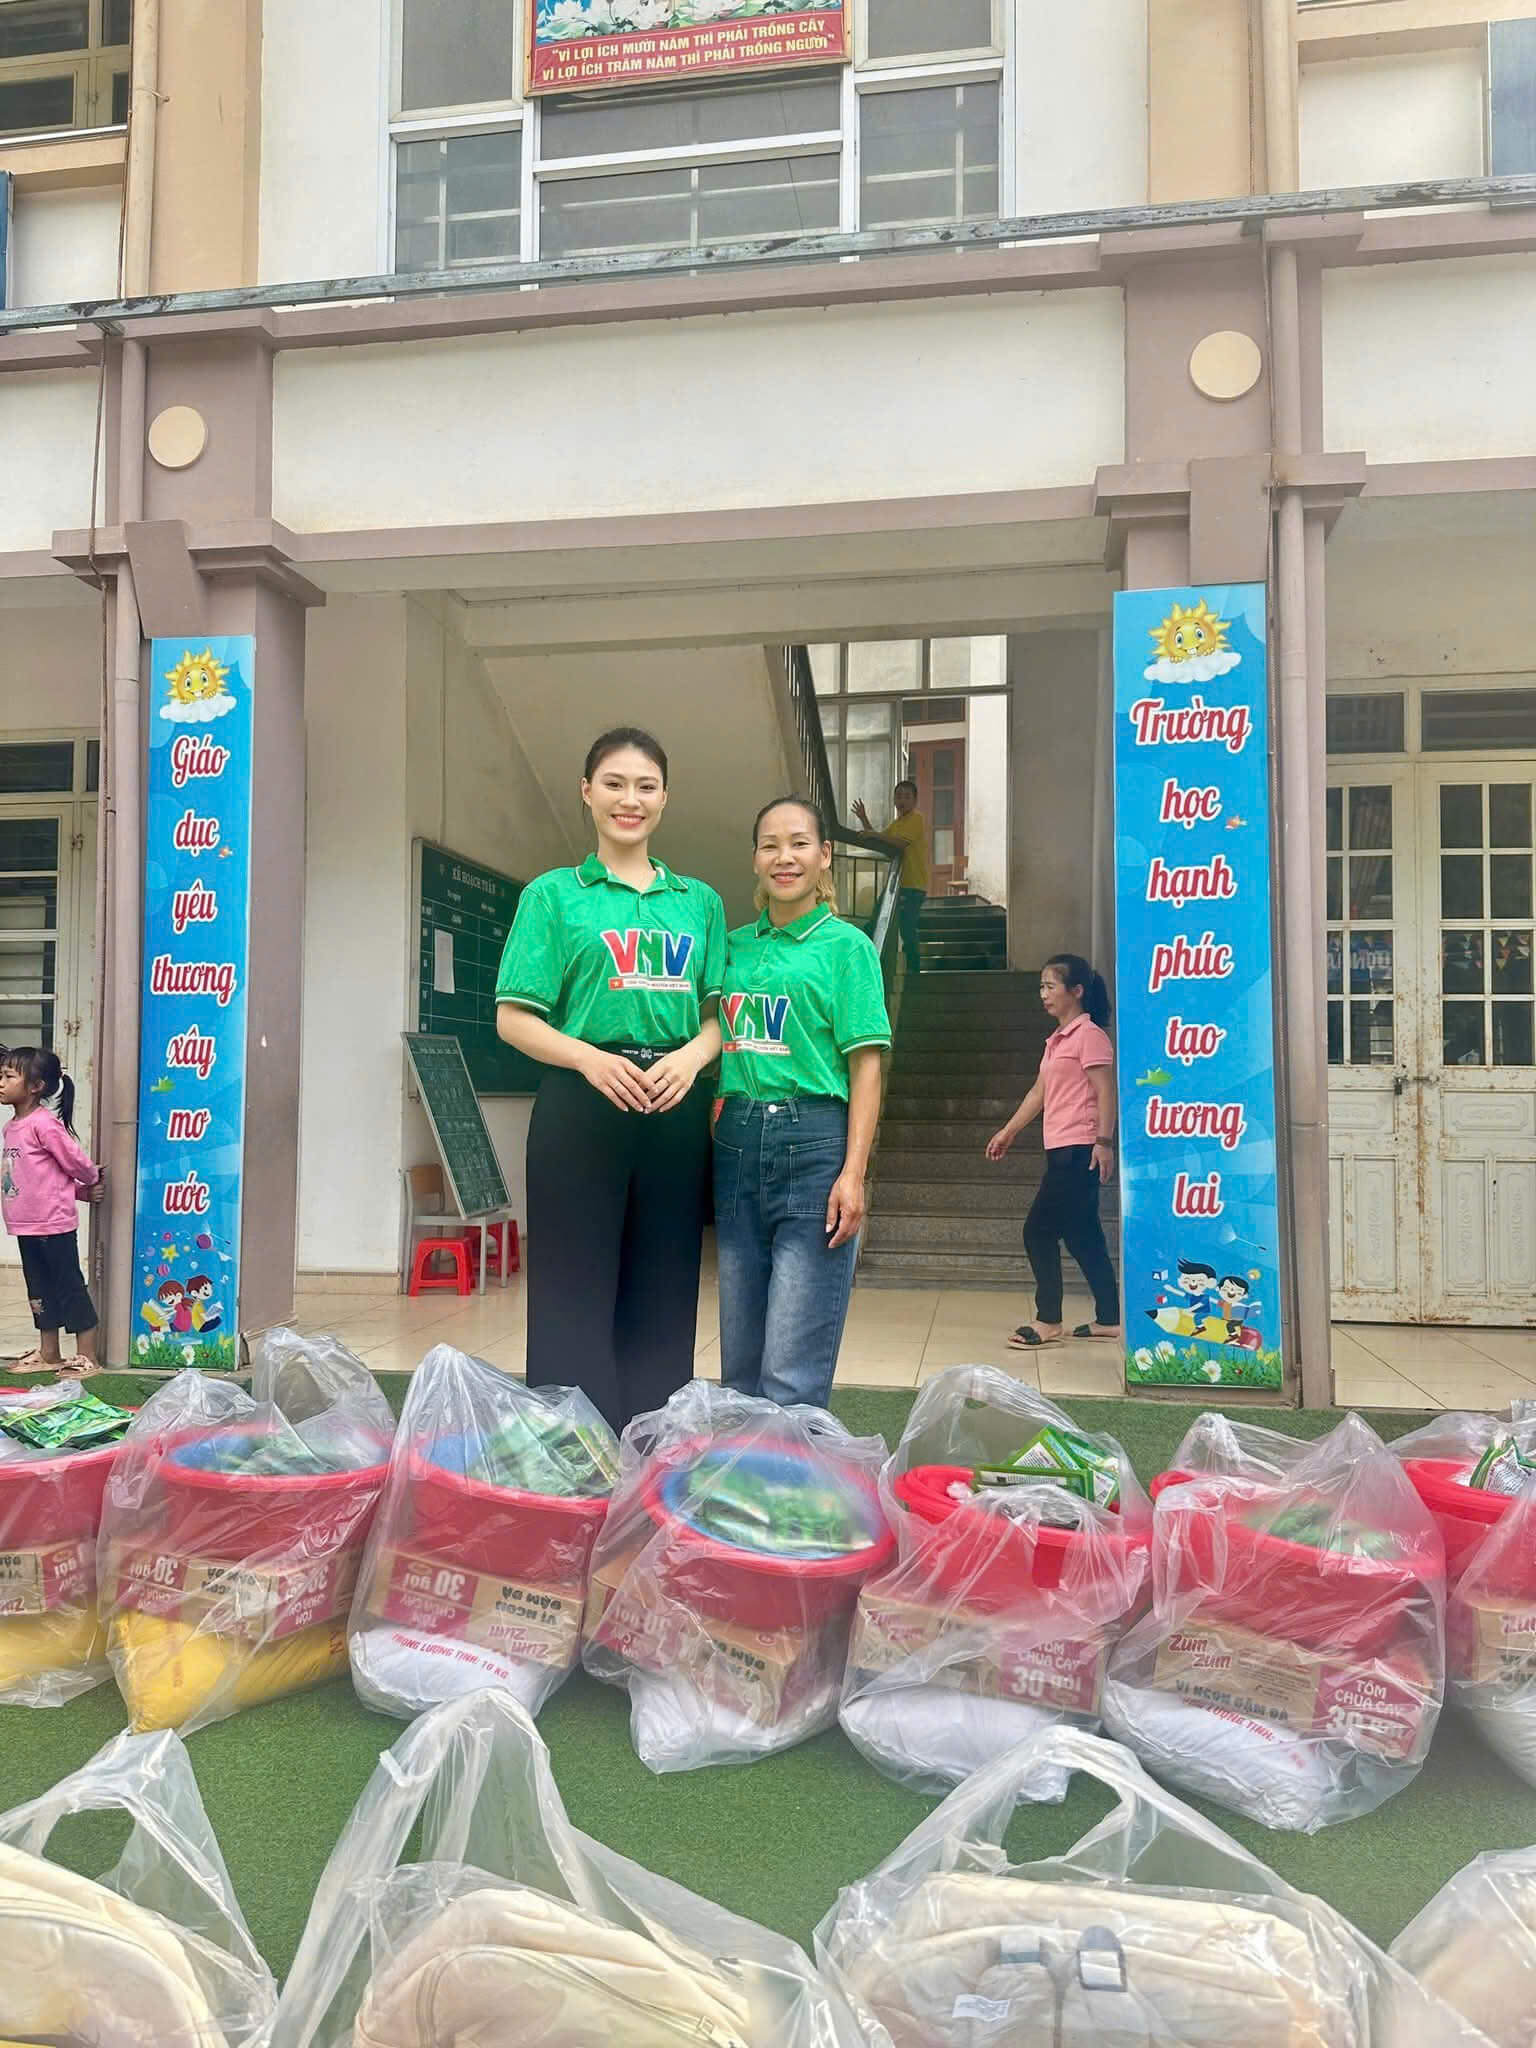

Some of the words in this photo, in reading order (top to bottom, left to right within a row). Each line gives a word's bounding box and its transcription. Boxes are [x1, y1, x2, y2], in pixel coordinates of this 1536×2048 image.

[542, 66, 554, 81] VÌ
[558, 64, 578, 80] LỢI
[581, 61, 603, 76] ÍCH
[606, 58, 642, 74] TRĂM
[646, 54, 677, 69] NĂM
[680, 50, 700, 65] THÌ
[704, 43, 736, 62] PHẢI
[739, 39, 782, 57] TRỒNG
[574, 46, 593, 61] LỢI
[597, 43, 619, 57] ÍCH
[622, 39, 656, 54] MƯỜI
[659, 36, 690, 51] NĂM
[693, 31, 714, 45] THÌ
[717, 25, 748, 43] PHẢI
[751, 21, 795, 38] TRỒNG
[799, 18, 825, 33] CÂY
[1131, 696, 1250, 751] Trường
[173, 735, 229, 786] Giáo
[1161, 779, 1220, 828] học
[175, 811, 218, 855] dục
[1148, 856, 1235, 907] hạnh
[174, 881, 216, 932] yêu
[602, 929, 694, 978] VNV
[1151, 933, 1233, 990] phúc
[152, 956, 234, 1006] thương
[168, 1026, 214, 1078] xây
[1167, 1018, 1225, 1064] tạo
[168, 1109, 209, 1139] mơ
[1147, 1097, 1244, 1148] tương
[164, 1172, 209, 1213] ước
[1174, 1174, 1222, 1215] lai
[154, 1556, 178, 1585] 30
[434, 1569, 466, 1601] 30
[1168, 1633, 1208, 1652] Zum
[1192, 1653, 1232, 1669] Zum
[481, 1659, 494, 1672] 10
[1011, 1665, 1045, 1697] 30
[1356, 1679, 1387, 1699] TÔM
